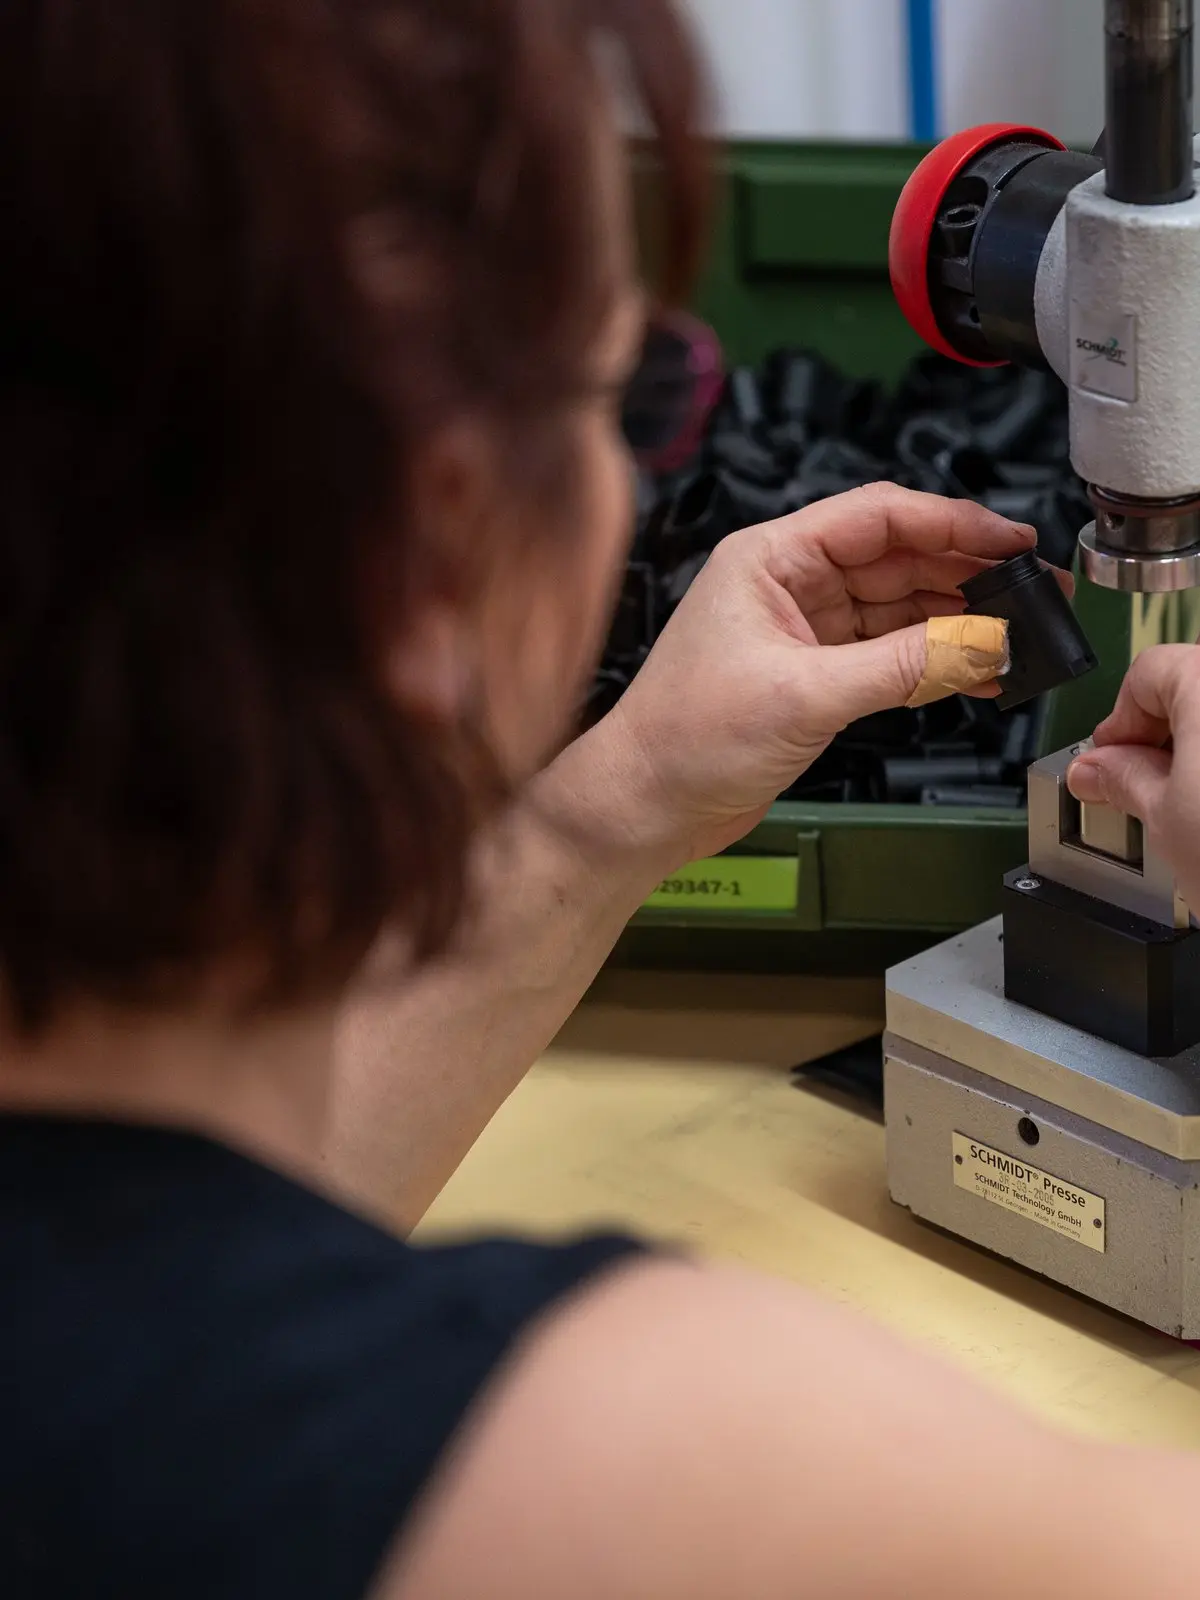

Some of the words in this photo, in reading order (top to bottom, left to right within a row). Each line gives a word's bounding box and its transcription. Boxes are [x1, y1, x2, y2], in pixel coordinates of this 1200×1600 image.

[653, 878, 741, 896] 29347-1
[974, 1172, 1010, 1195] SCHMIDT
[1012, 1189, 1056, 1217] Technology
[1057, 1210, 1082, 1228] GmbH
[1043, 1176, 1086, 1208] Presse
